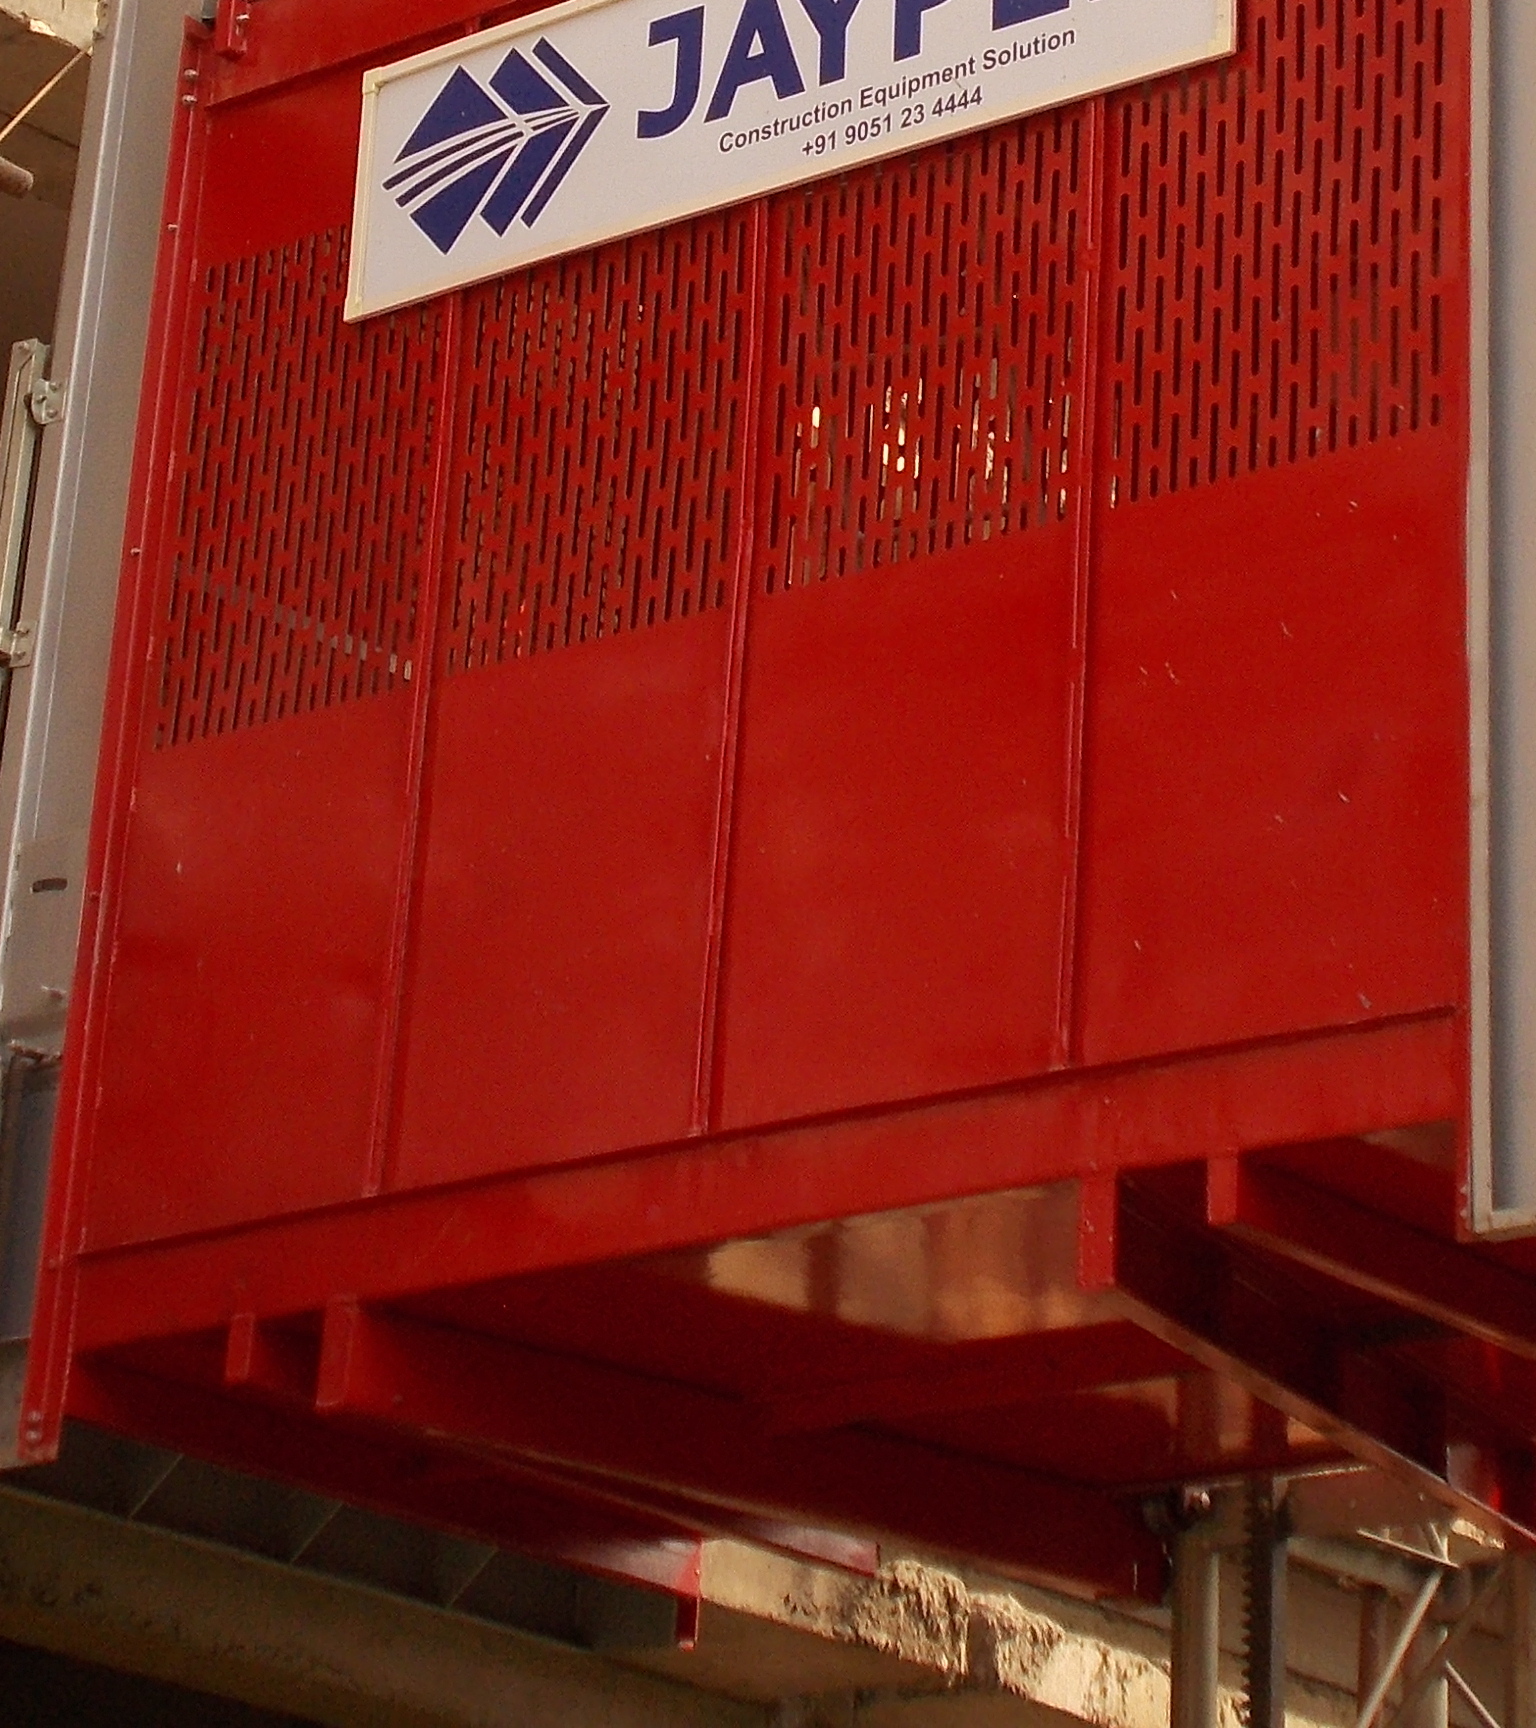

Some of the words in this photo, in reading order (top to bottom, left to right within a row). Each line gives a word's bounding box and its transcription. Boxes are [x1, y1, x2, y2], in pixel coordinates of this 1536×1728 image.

[718, 97, 853, 152] Construction
[859, 55, 976, 108] Equipment
[983, 29, 1075, 70] Solution
[801, 130, 837, 156] +91
[844, 115, 893, 146] 9051
[900, 103, 925, 129] 23
[933, 86, 983, 118] 4444
